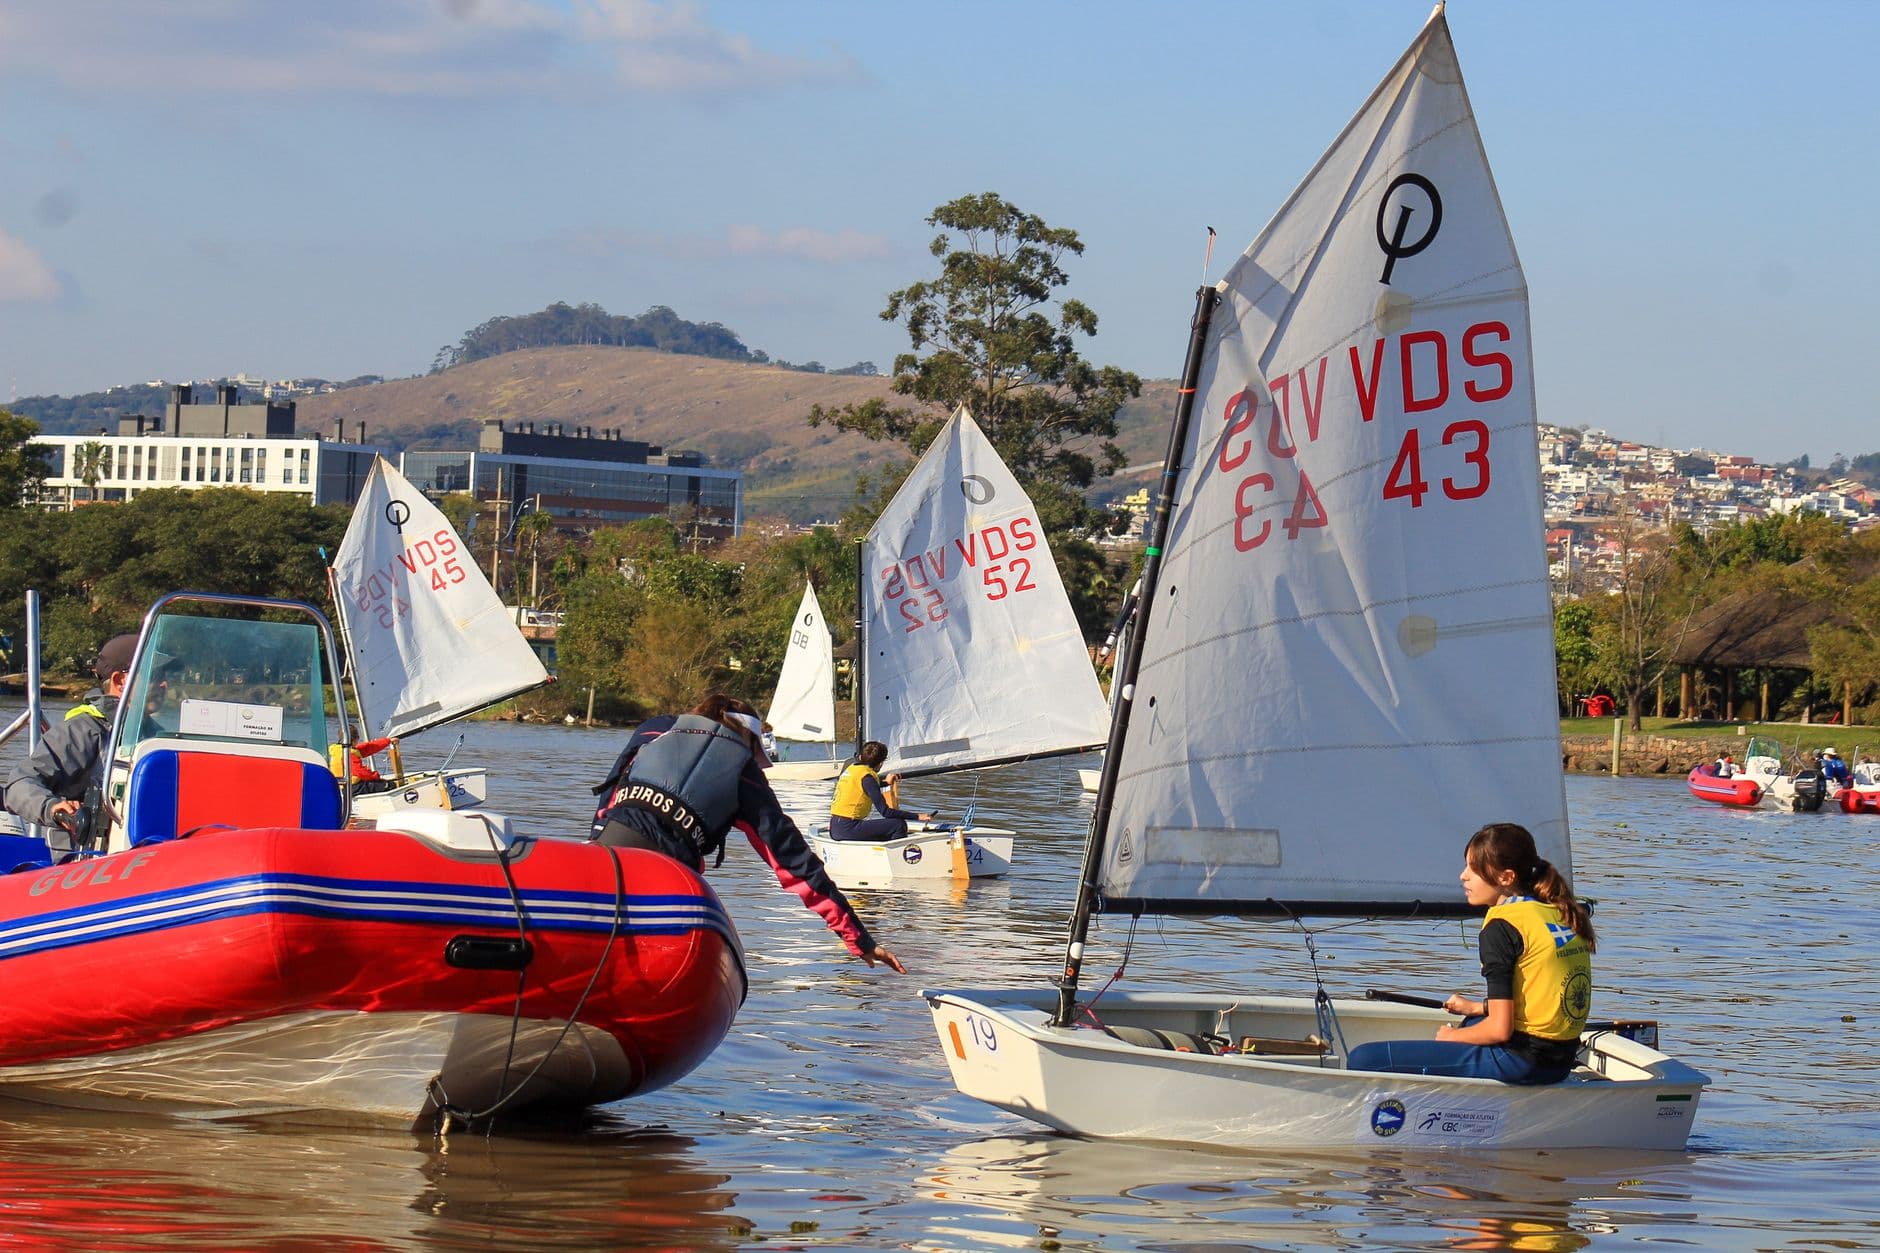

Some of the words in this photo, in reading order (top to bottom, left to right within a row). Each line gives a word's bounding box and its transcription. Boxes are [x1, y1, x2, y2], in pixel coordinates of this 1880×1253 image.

[1349, 321, 1513, 423] VDS
[1383, 419, 1491, 508] 43
[397, 530, 457, 575] VDS
[955, 517, 1036, 568] VDS
[431, 557, 466, 591] 45
[984, 558, 1036, 602] 52
[449, 784, 466, 797] 25
[673, 807, 695, 829] DO
[29, 851, 158, 897] GOLF
[966, 848, 983, 864] 24
[966, 1014, 997, 1051] 19
